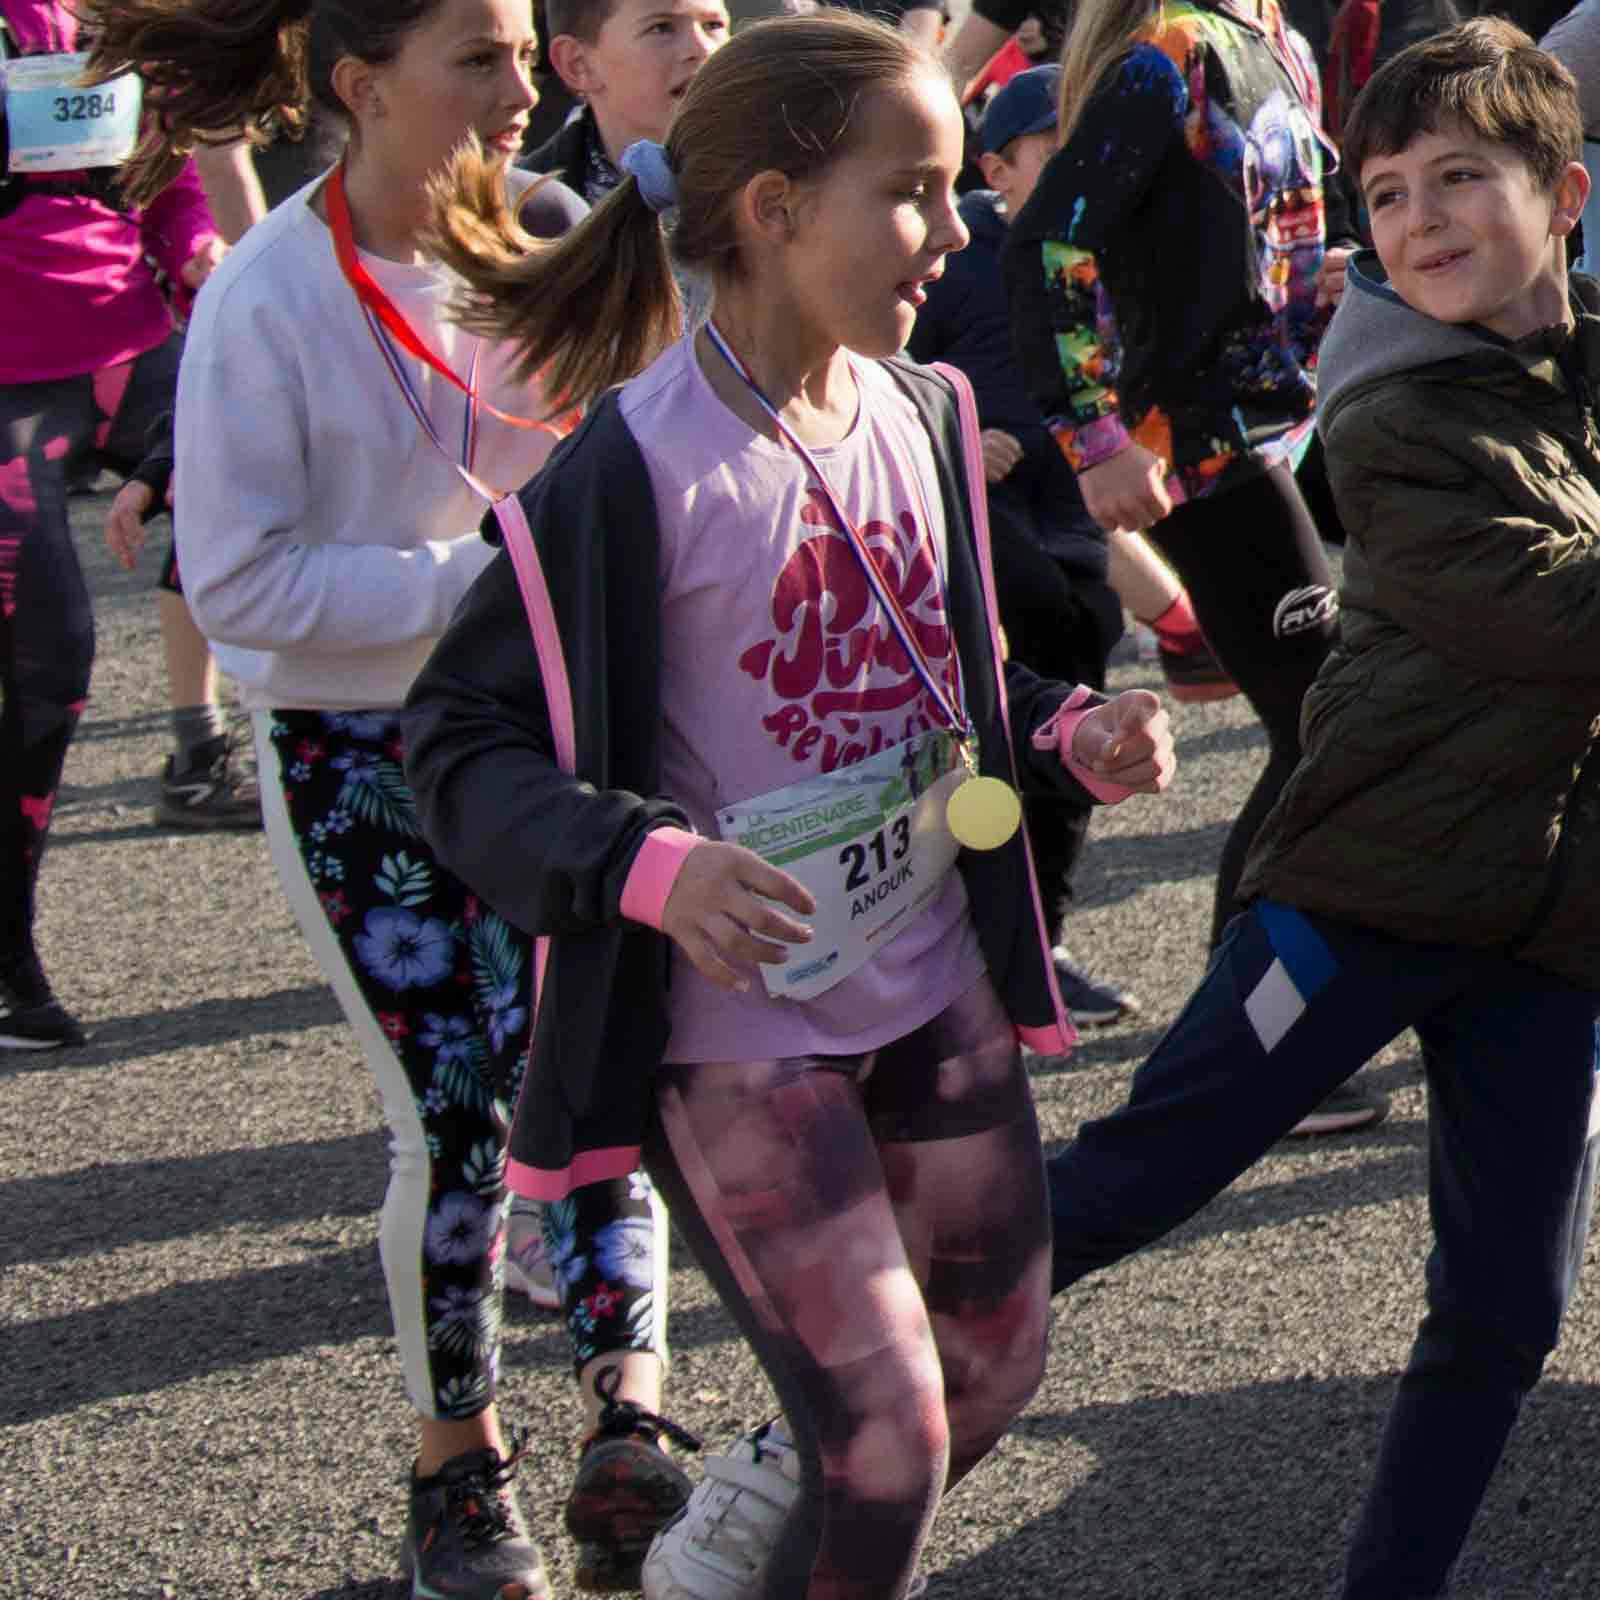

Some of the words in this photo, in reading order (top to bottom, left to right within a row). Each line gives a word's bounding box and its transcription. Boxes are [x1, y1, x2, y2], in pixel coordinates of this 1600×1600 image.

[53, 93, 115, 122] 3284
[748, 812, 768, 828] LA
[838, 814, 911, 893] 213
[850, 859, 914, 921] ANOUK
